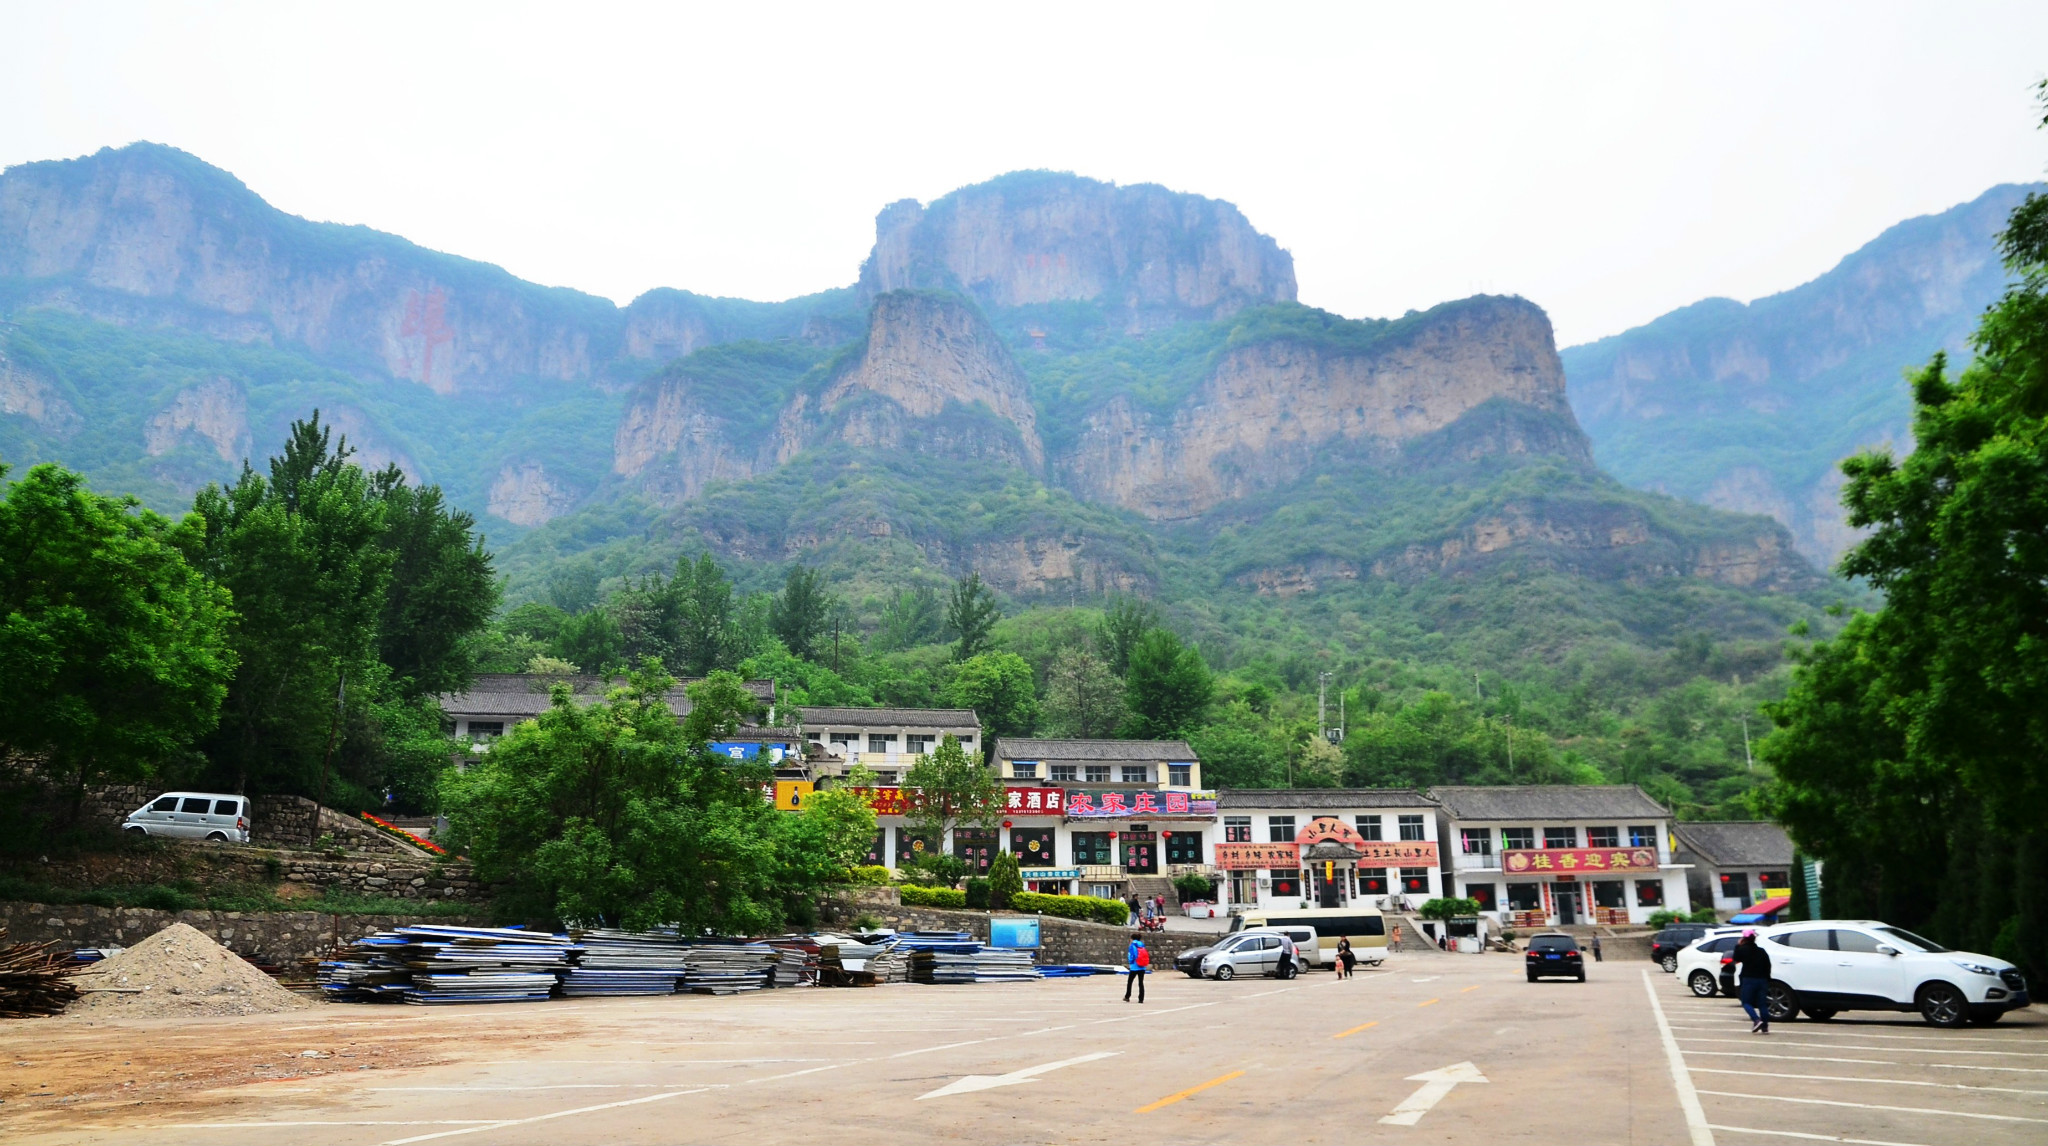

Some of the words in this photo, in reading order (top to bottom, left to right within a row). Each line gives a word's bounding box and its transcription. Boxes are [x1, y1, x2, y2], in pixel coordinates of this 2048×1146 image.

[1069, 792, 1188, 813] 农家庄园
[1532, 852, 1631, 869] 桂香迎宾
